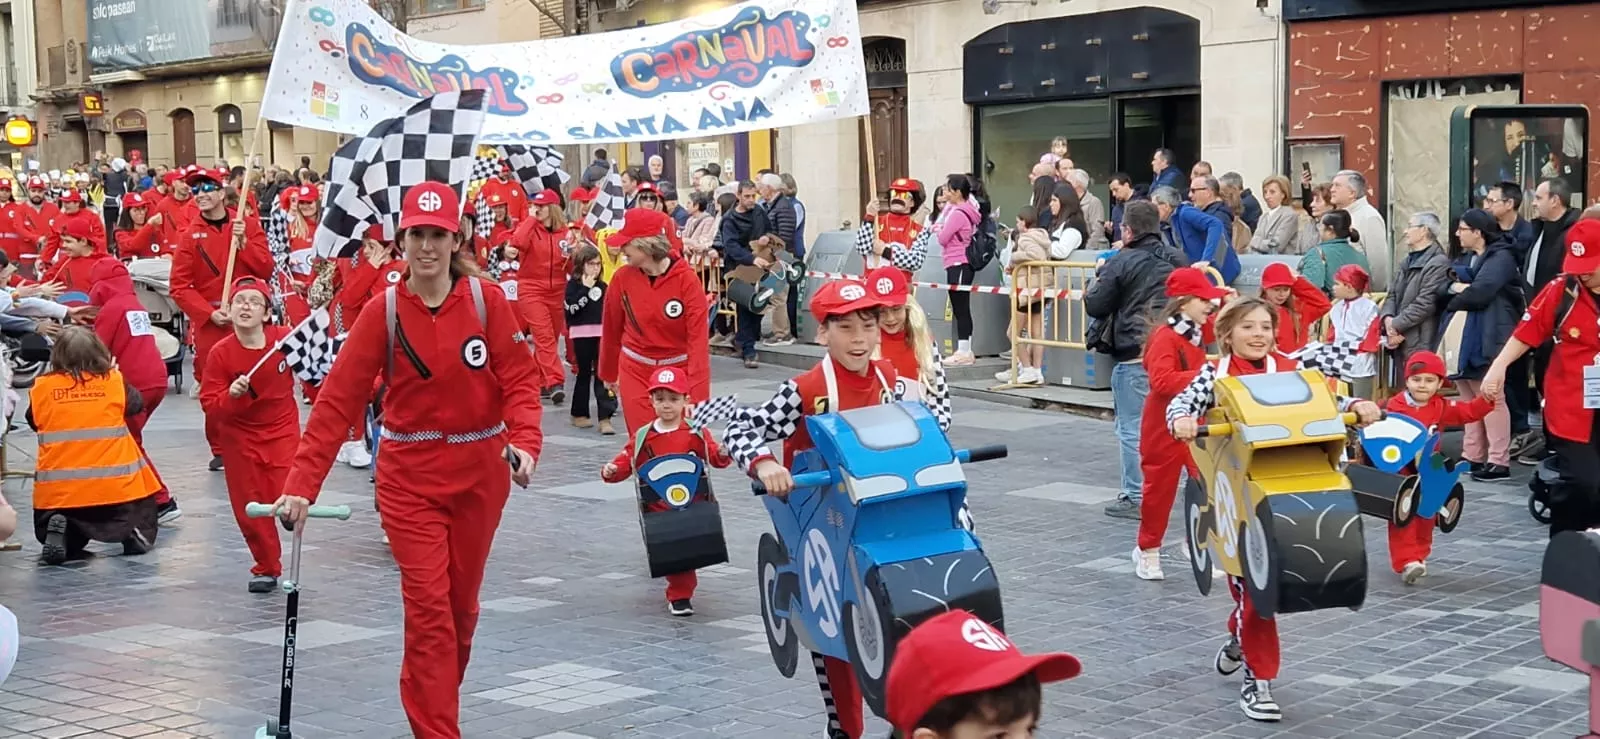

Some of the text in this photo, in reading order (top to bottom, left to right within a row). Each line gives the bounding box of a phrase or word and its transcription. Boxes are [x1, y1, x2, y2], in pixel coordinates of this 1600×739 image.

[567, 96, 774, 140] SANTA ANA
[418, 191, 442, 212] SA
[840, 284, 866, 301] SA
[876, 277, 894, 295] SA
[670, 304, 679, 314] 5
[472, 345, 482, 361] 5
[804, 528, 840, 638] SA
